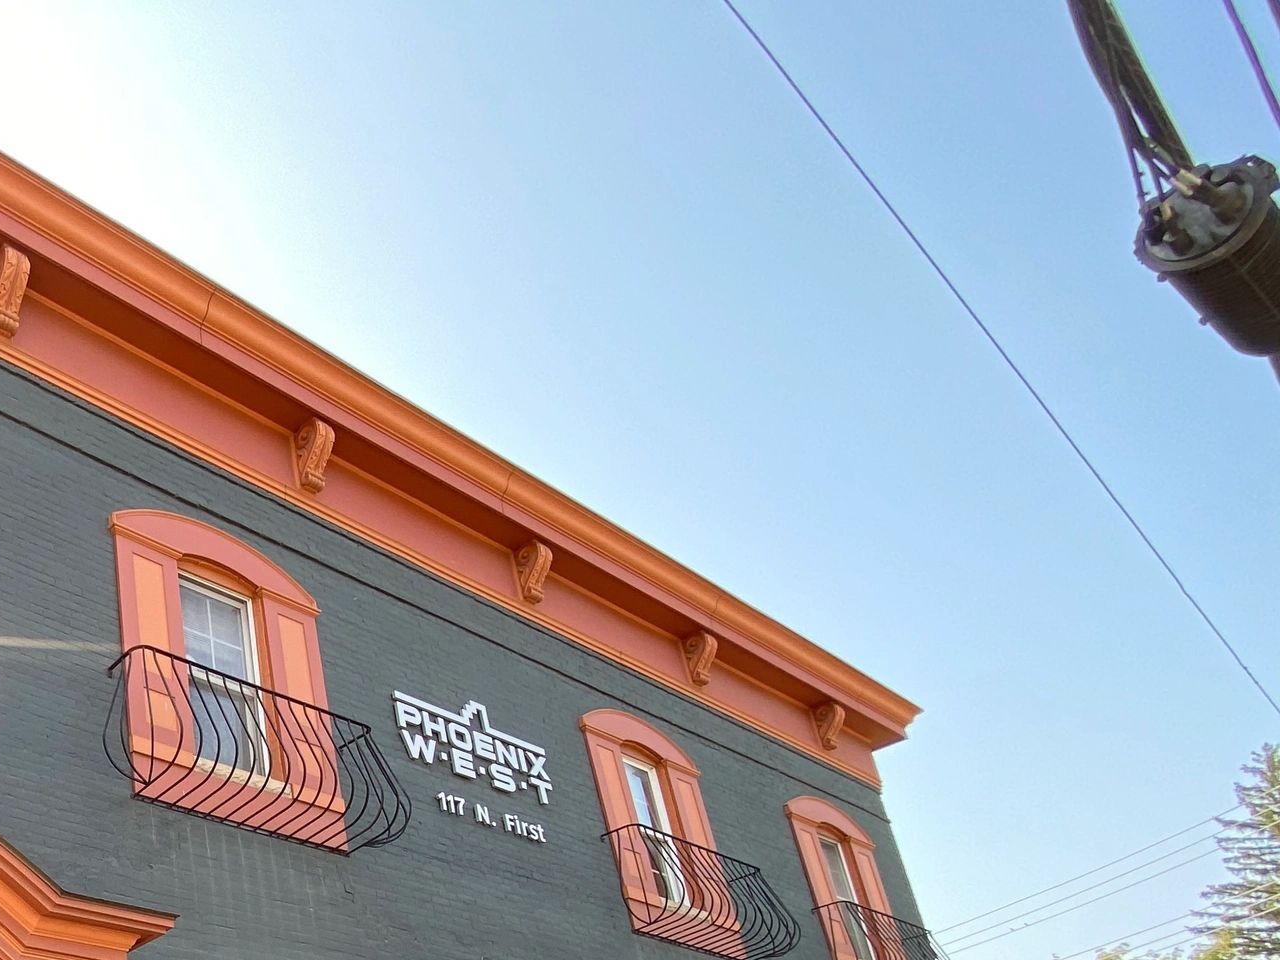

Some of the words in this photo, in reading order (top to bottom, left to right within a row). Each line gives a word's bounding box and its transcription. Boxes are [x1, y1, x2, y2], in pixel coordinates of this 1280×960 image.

[395, 700, 551, 782] PHOENIX
[435, 791, 465, 816] 117
[473, 803, 497, 827] N.
[502, 813, 546, 843] First
